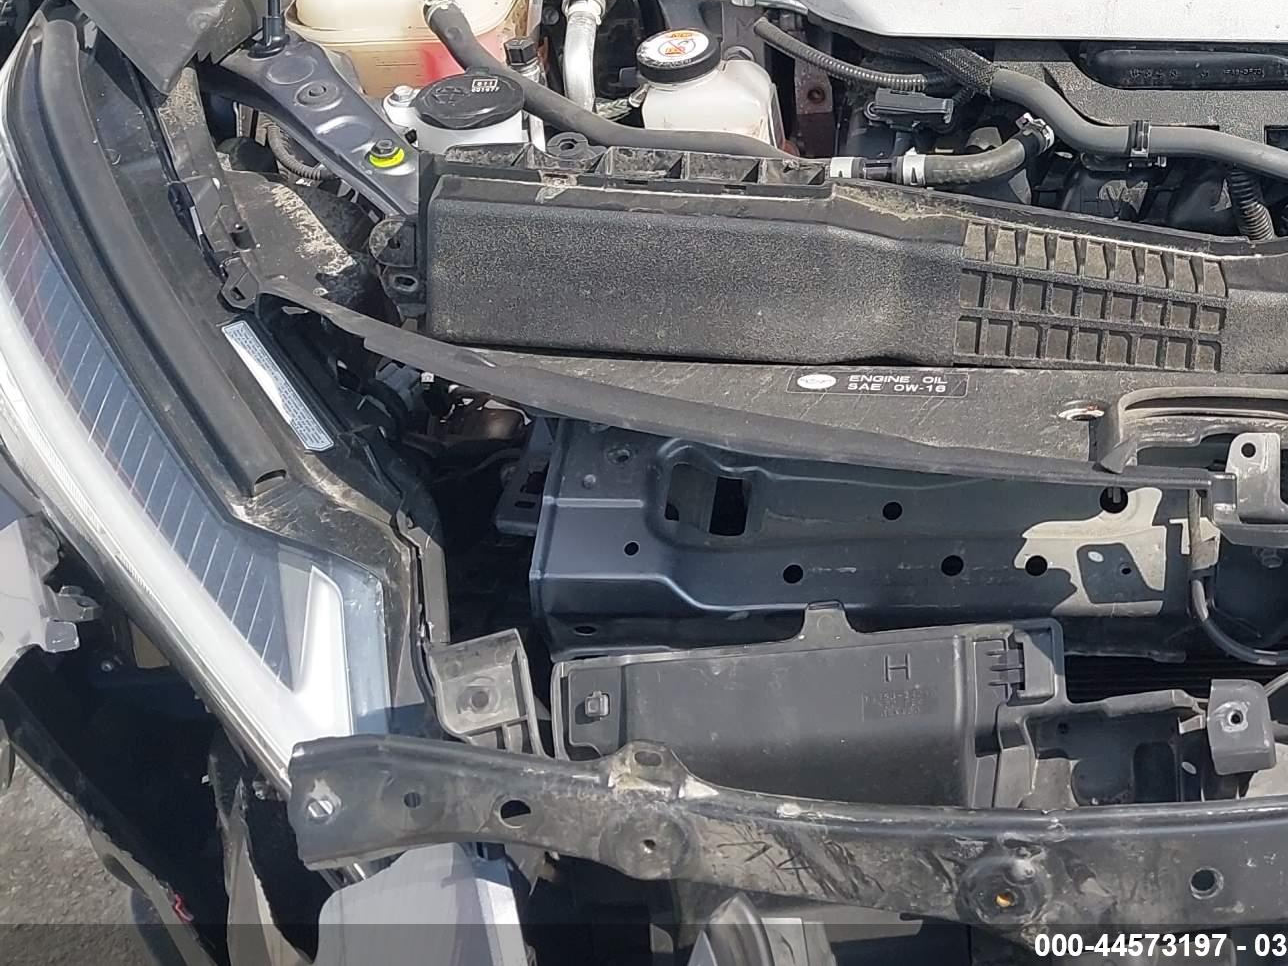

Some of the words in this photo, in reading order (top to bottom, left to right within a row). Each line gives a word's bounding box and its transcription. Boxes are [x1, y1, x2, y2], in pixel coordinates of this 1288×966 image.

[848, 375, 911, 384] ENGINE
[921, 376, 948, 385] OIL
[847, 383, 882, 392] SAE
[893, 384, 946, 393] 0W-16
[883, 653, 911, 682] H
